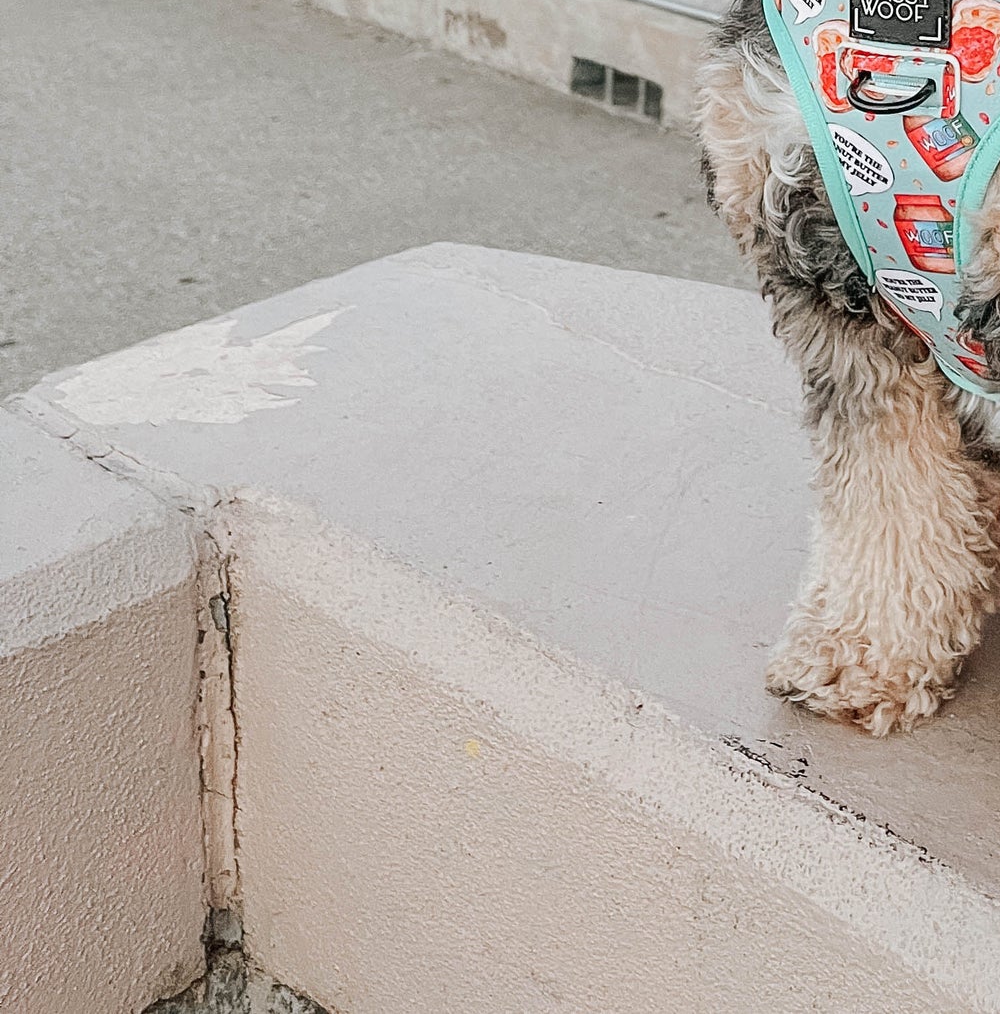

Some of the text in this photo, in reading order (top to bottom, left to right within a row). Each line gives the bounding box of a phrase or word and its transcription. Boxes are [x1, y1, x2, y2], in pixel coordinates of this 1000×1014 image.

[919, 119, 963, 152] WOOF
[834, 131, 883, 171] YOU'RE THE
[850, 168, 877, 187] JELLY
[854, 158, 889, 185] BUTTER
